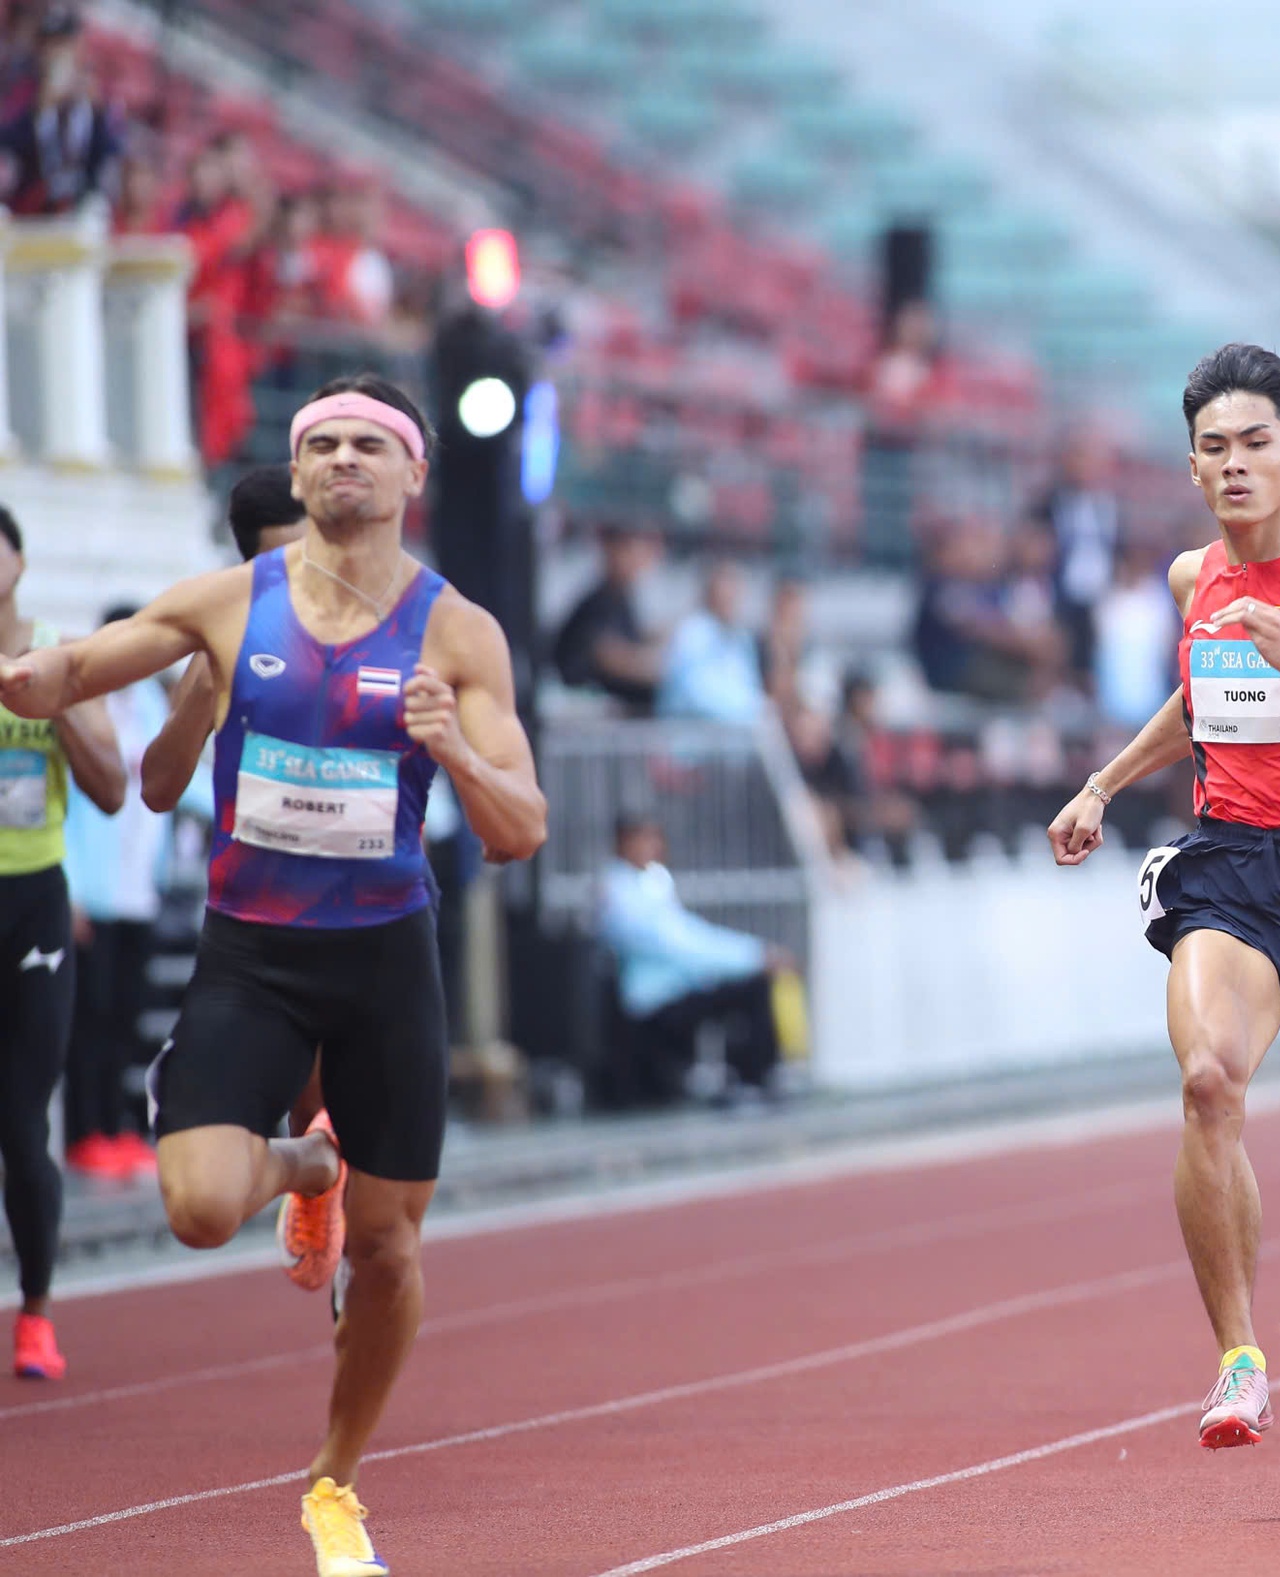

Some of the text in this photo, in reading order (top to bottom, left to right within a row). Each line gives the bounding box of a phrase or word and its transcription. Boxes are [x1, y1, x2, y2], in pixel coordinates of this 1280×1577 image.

[1222, 651, 1243, 669] SEA
[1224, 690, 1266, 702] TUONG
[1208, 724, 1238, 733] THAILAND
[281, 796, 346, 815] ROBERT
[1140, 855, 1165, 911] 5
